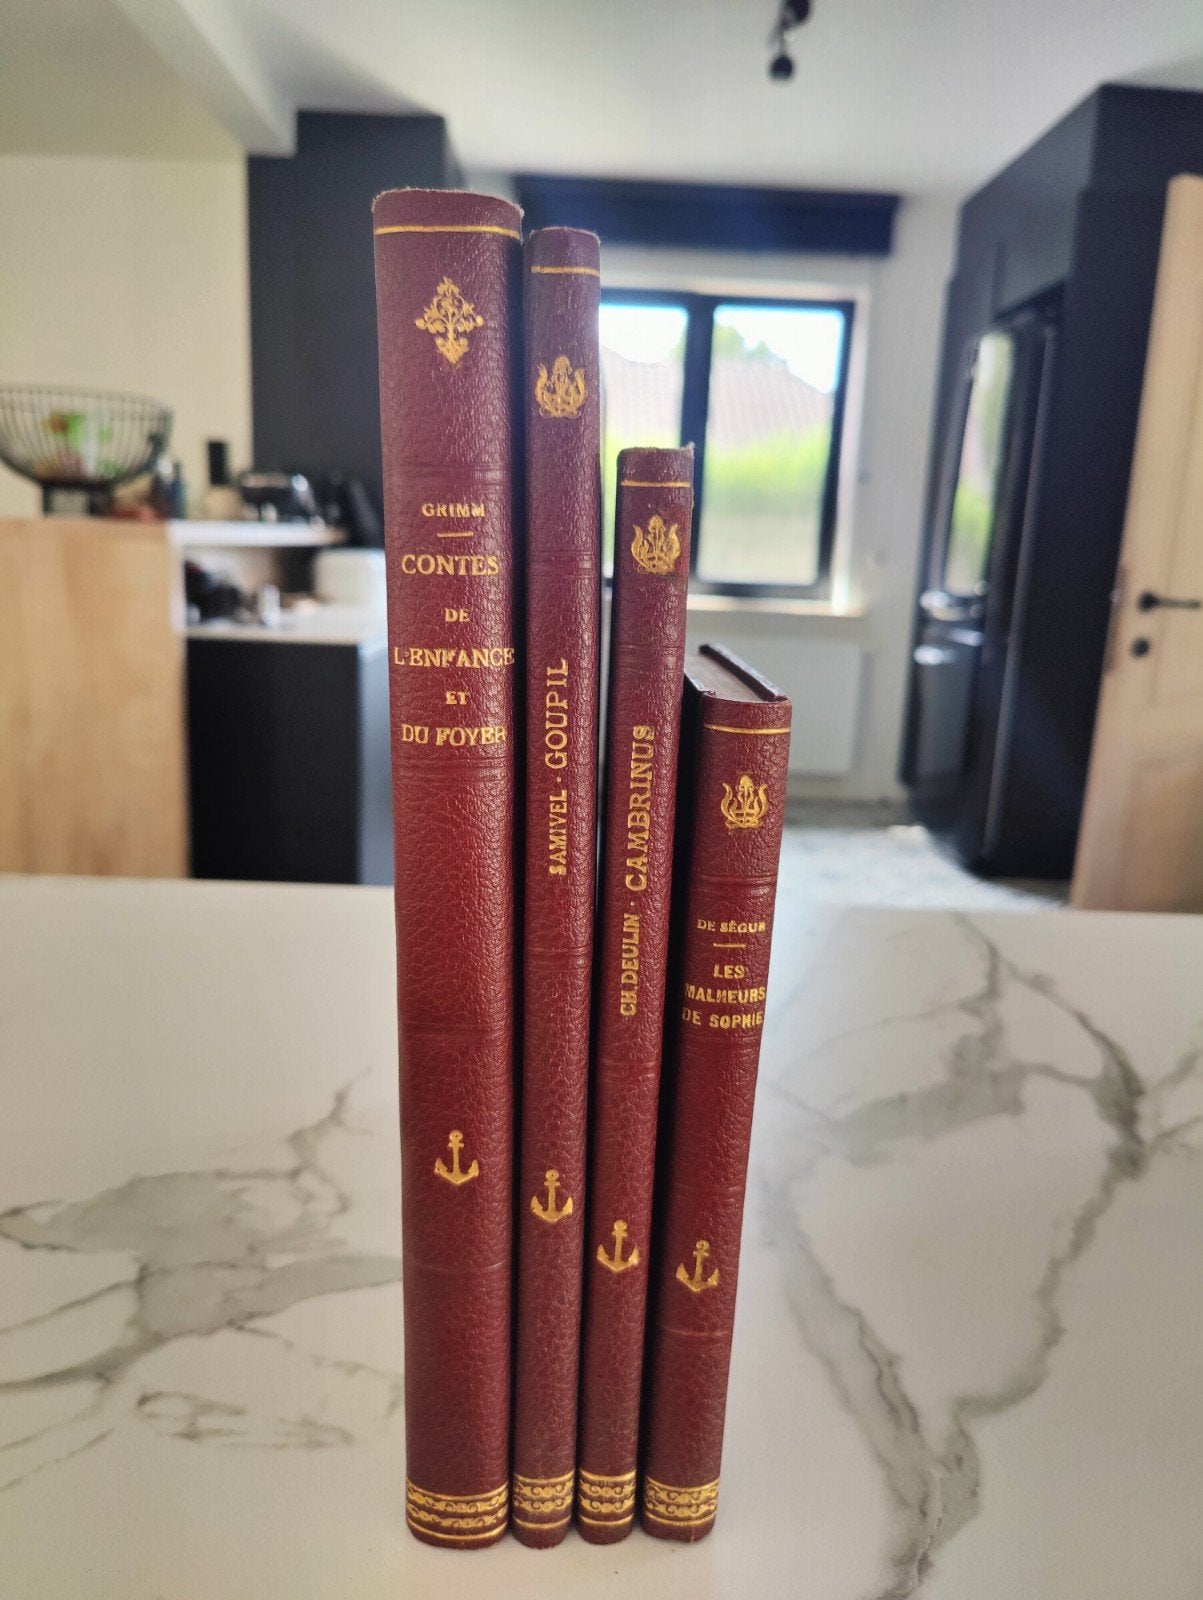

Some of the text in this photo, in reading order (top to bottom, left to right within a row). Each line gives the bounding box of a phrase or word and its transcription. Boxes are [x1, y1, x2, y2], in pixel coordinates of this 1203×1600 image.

[421, 503, 486, 518] GRIMM
[401, 554, 501, 576] CONTES
[445, 607, 470, 623] DE
[446, 690, 470, 705] ET
[401, 723, 508, 747] DU FOYER
[545, 657, 569, 876] SAMIVEL GOUPIL
[625, 724, 655, 892] CAMBRINUS
[697, 918, 717, 932] DE
[713, 963, 746, 979] LES
[684, 982, 767, 1004] MALHEURS
[681, 1006, 765, 1030] DE SOPHIE
